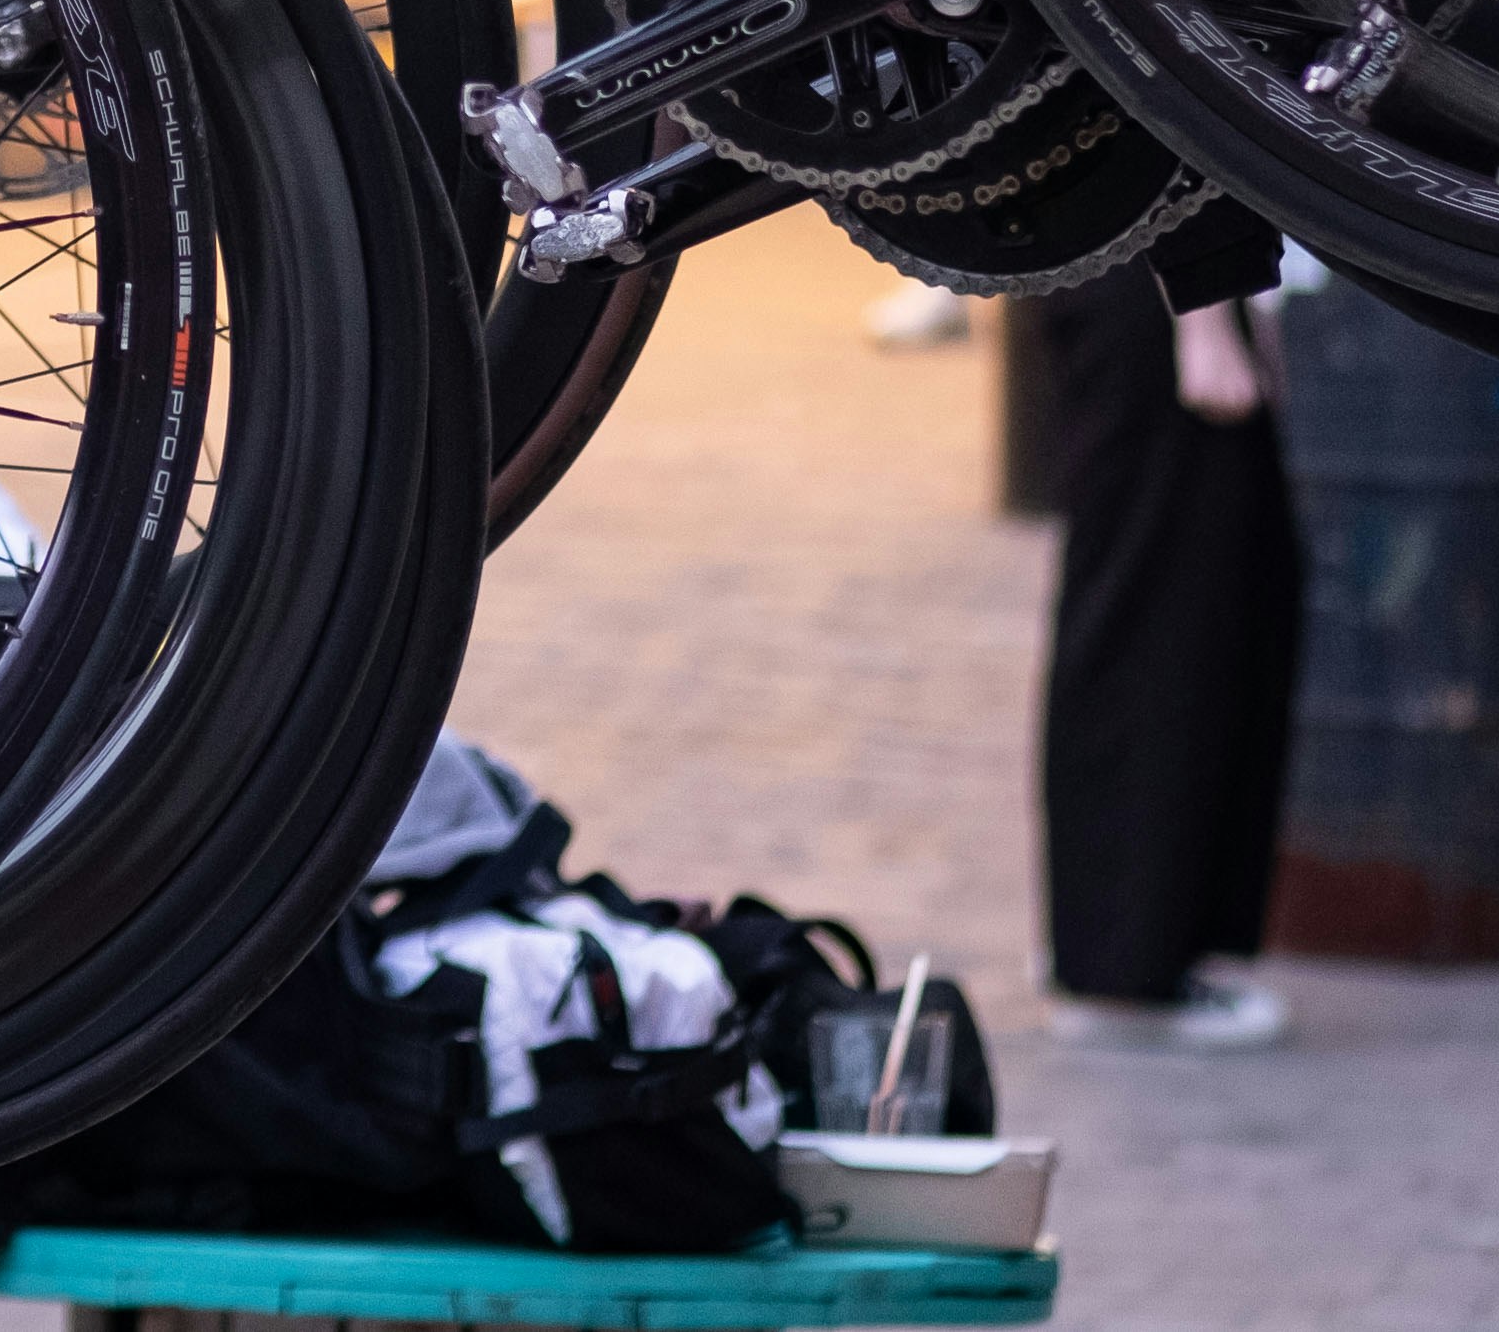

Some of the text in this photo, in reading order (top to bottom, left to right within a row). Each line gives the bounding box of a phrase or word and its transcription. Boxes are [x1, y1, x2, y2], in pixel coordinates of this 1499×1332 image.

[149, 48, 191, 258] SCHWALBE
[140, 388, 186, 542] PRO ONE
